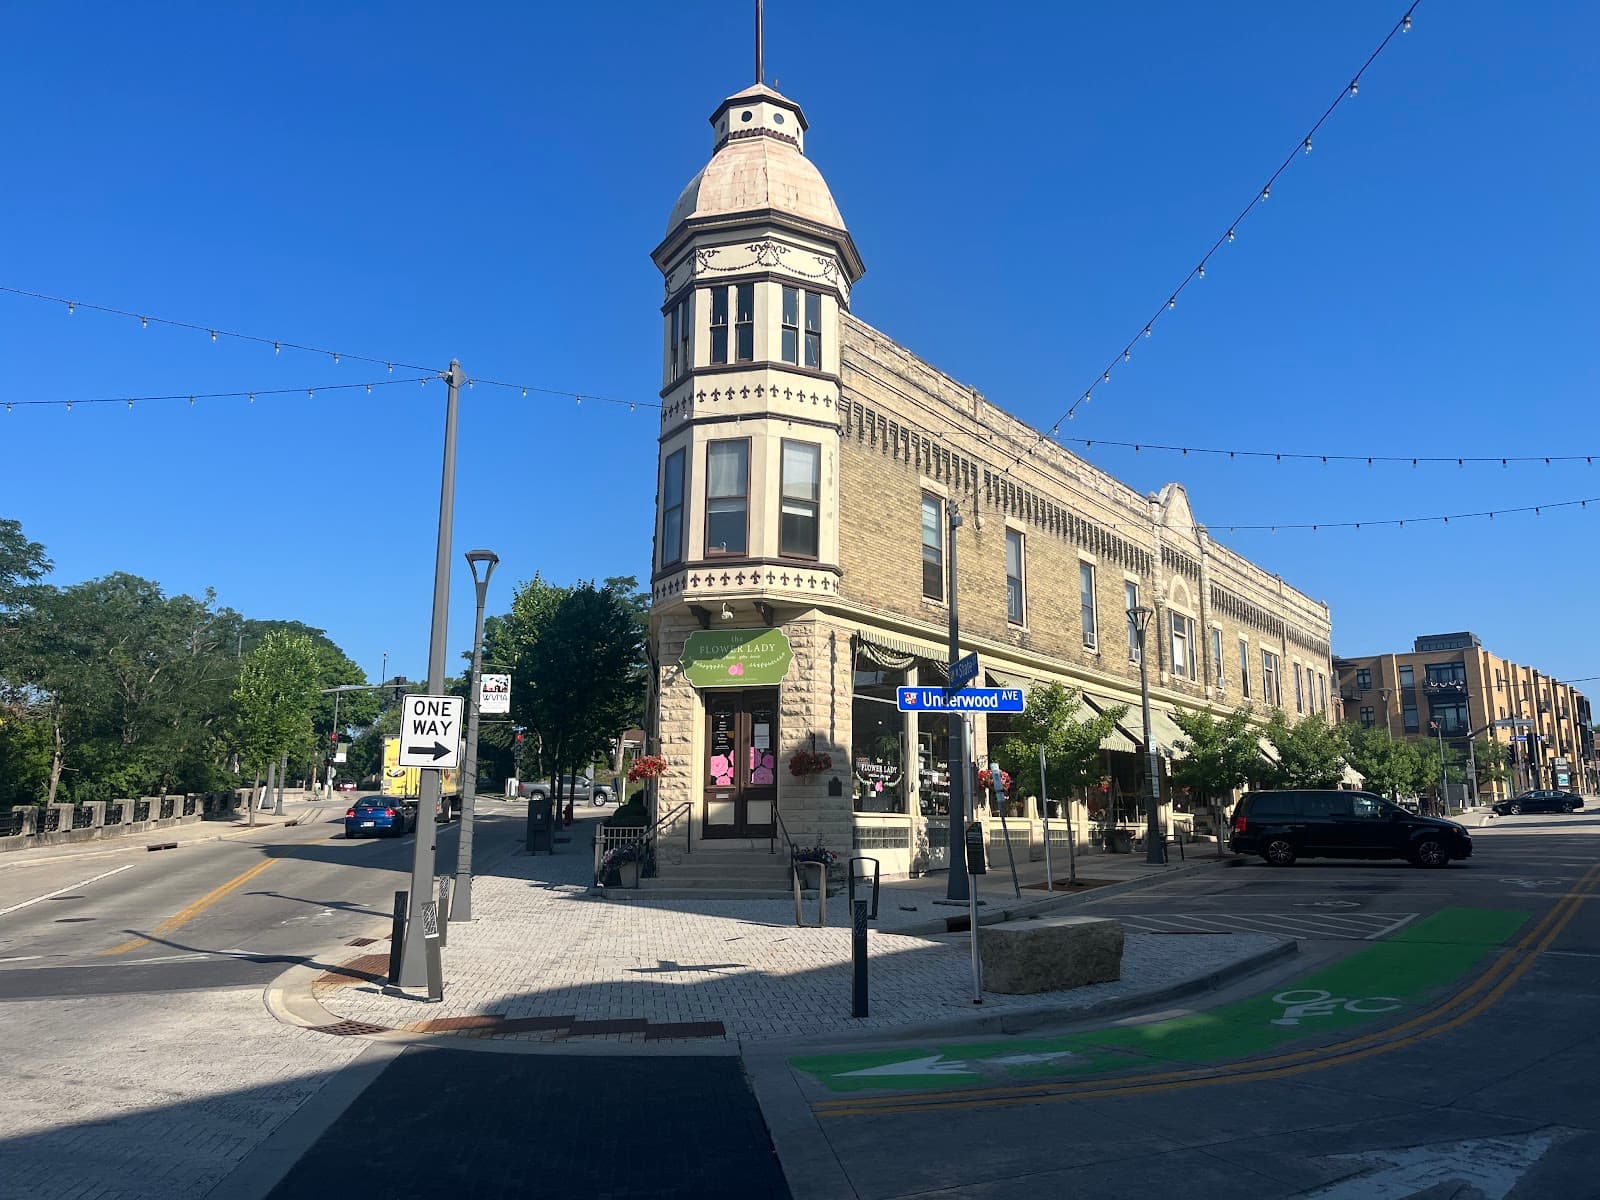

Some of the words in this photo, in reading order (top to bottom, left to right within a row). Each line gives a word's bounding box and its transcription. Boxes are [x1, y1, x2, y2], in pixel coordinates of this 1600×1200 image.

[699, 645, 743, 655] FLOWER
[747, 643, 776, 653] LADY
[922, 691, 998, 708] Underwood
[1001, 690, 1019, 701] AVE
[414, 700, 452, 716] ONE
[413, 719, 452, 736] WAY
[861, 763, 883, 773] FLOWER
[883, 765, 898, 774] LADY
